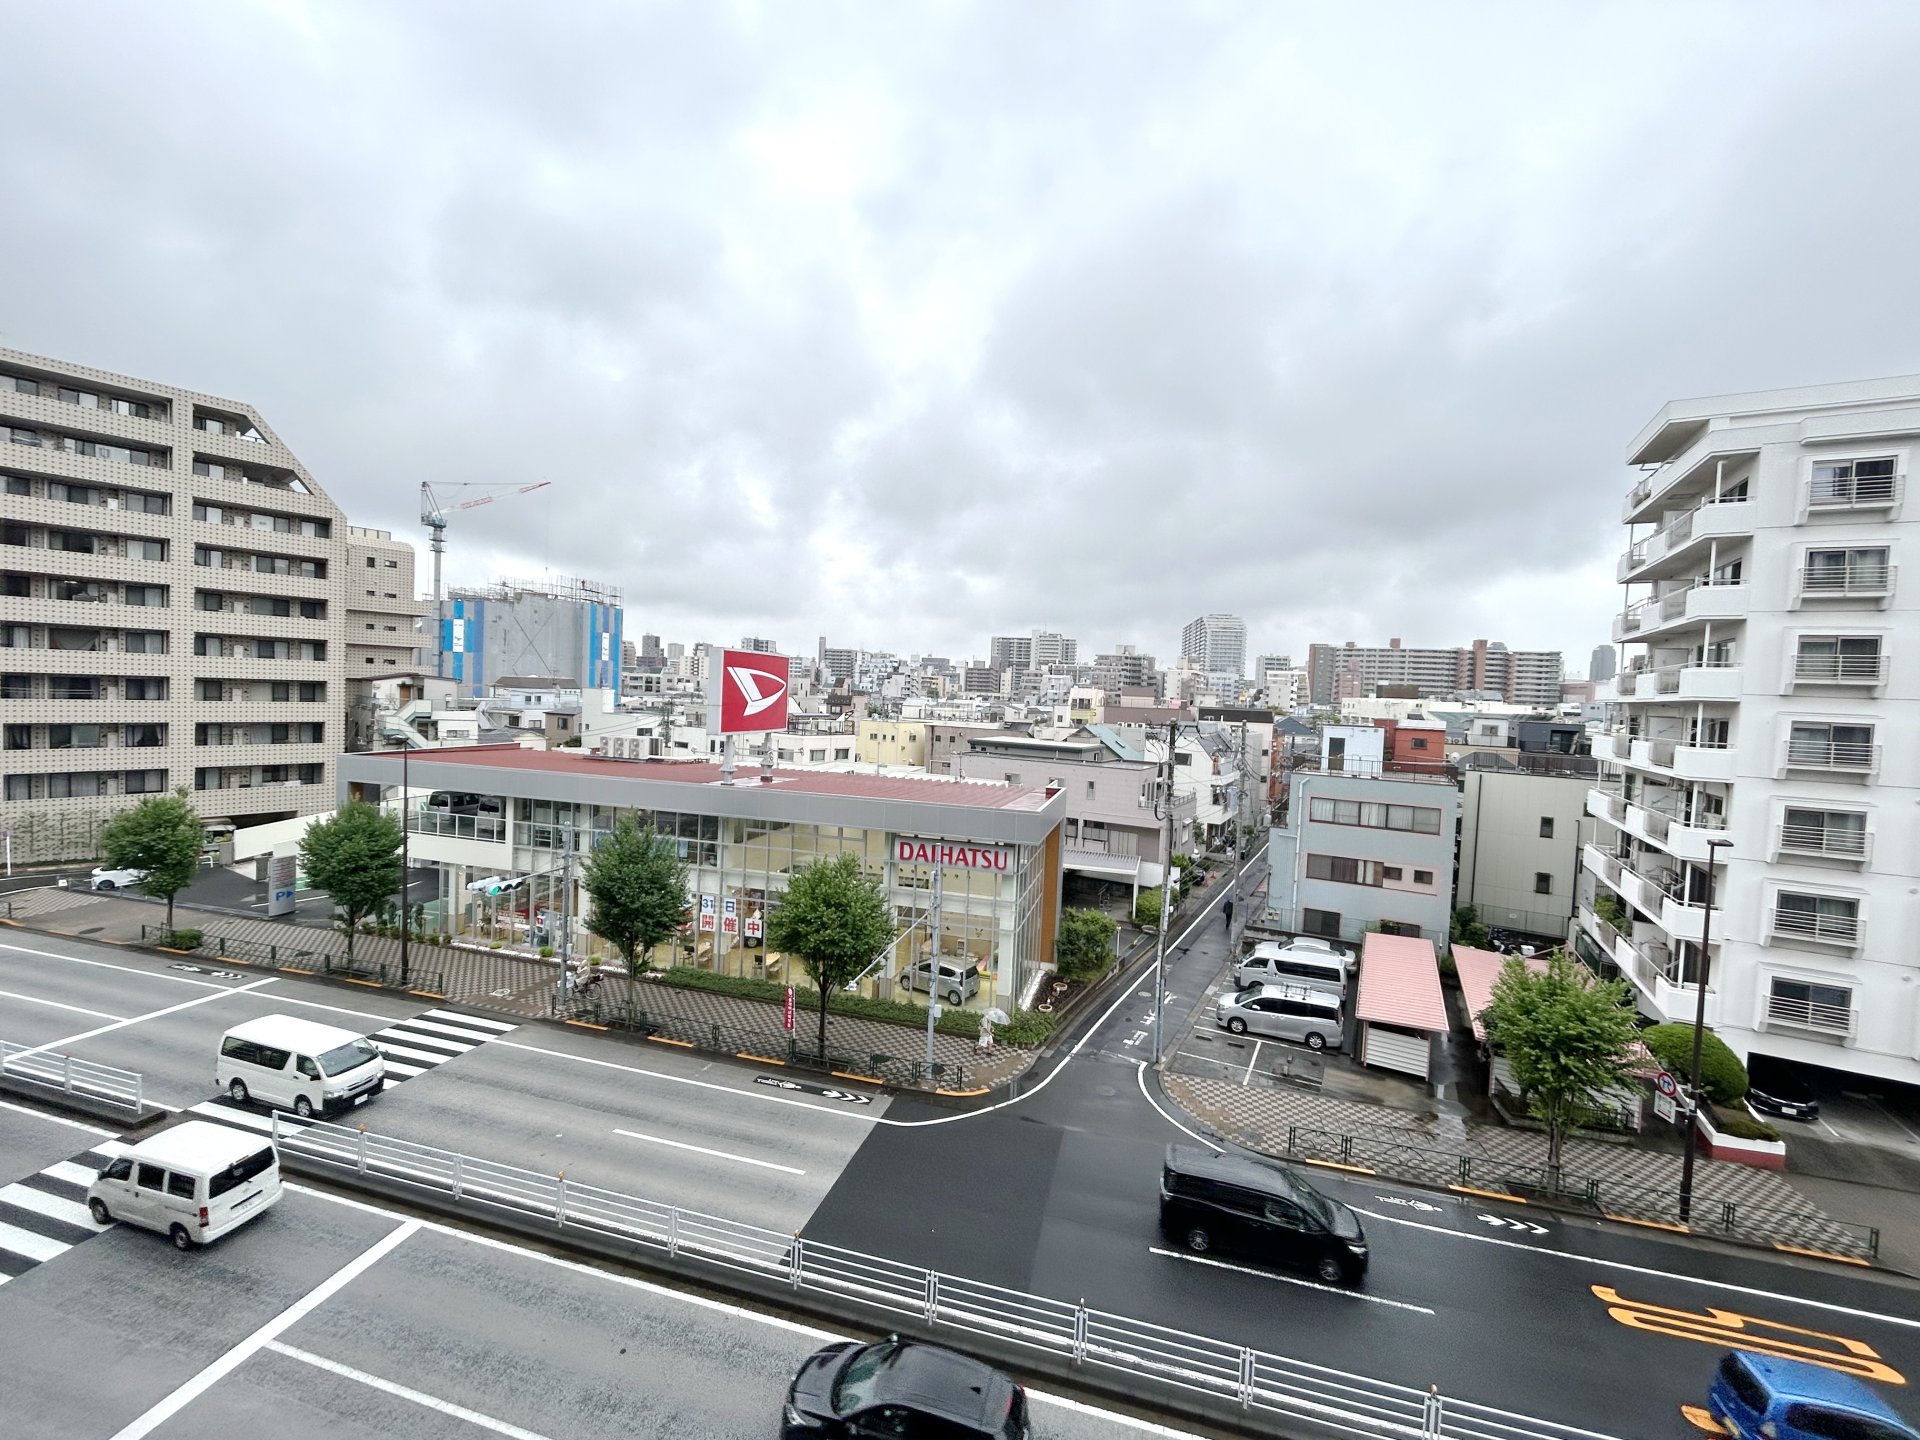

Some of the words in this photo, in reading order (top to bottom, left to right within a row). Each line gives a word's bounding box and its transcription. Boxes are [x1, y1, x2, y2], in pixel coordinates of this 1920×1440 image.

[899, 841, 1008, 871] DAIHATSU
[276, 891, 286, 901] P
[702, 914, 760, 935] 開催中
